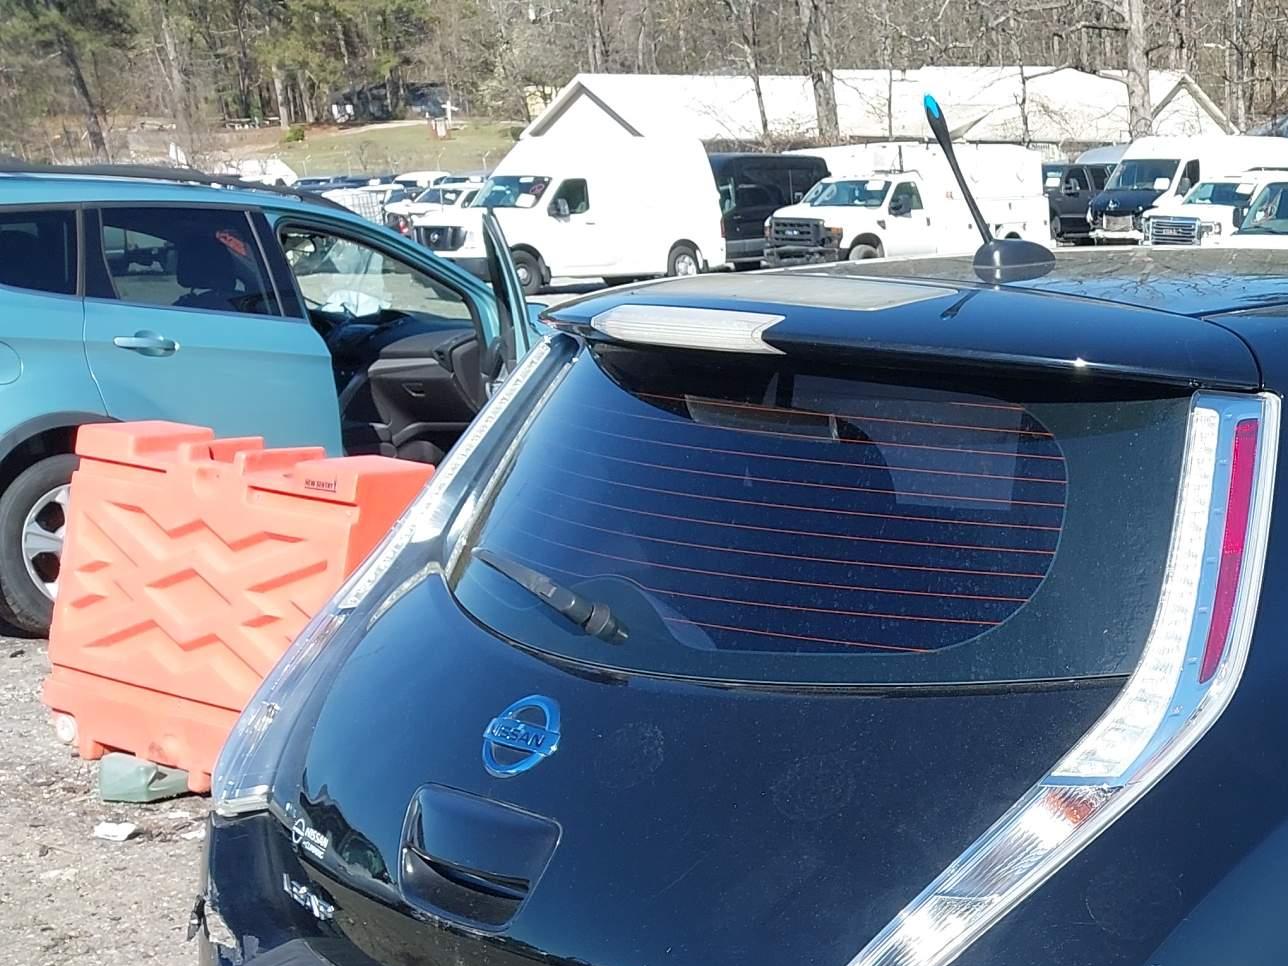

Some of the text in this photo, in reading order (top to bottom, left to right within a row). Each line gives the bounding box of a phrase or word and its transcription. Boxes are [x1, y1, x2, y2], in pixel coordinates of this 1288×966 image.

[491, 723, 546, 748] NISSAN
[305, 827, 329, 849] NISSAN
[283, 873, 335, 920] LEAF
